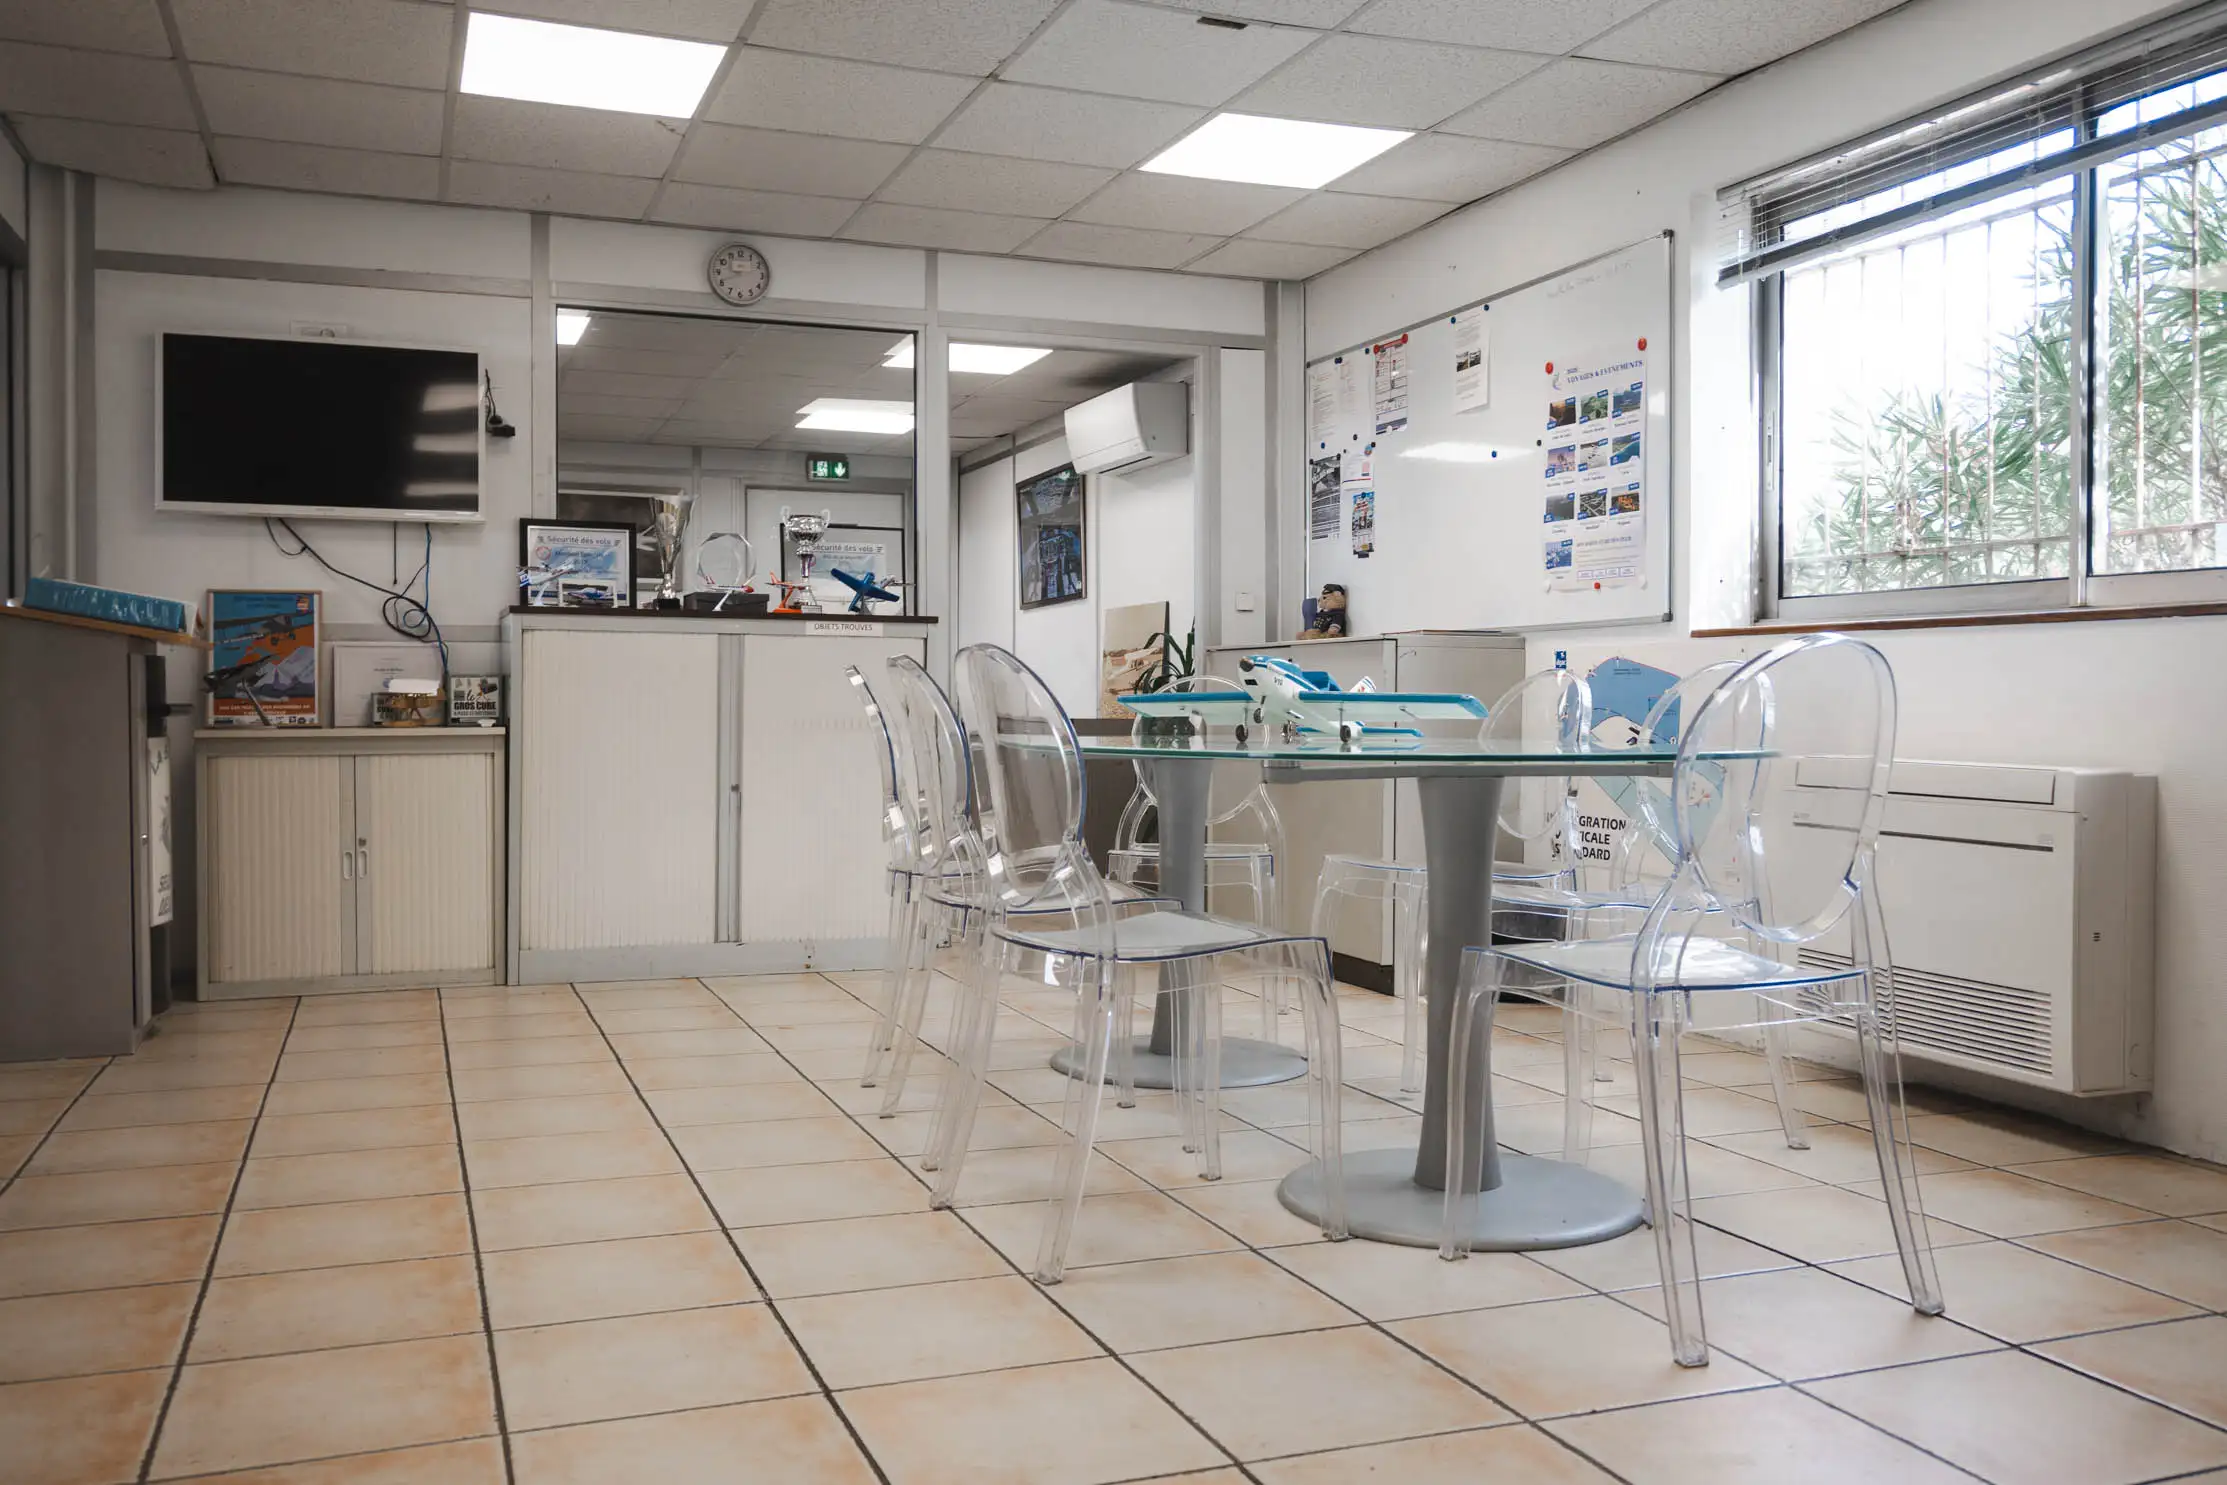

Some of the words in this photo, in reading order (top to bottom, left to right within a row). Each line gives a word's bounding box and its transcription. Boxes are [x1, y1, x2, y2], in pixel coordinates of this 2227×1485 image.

[547, 535, 579, 544] Sécurité
[581, 537, 594, 545] des
[814, 622, 840, 630] OBJETS
[841, 623, 873, 631] TROUVES
[454, 701, 475, 710] GROS
[476, 701, 497, 710] CUBE
